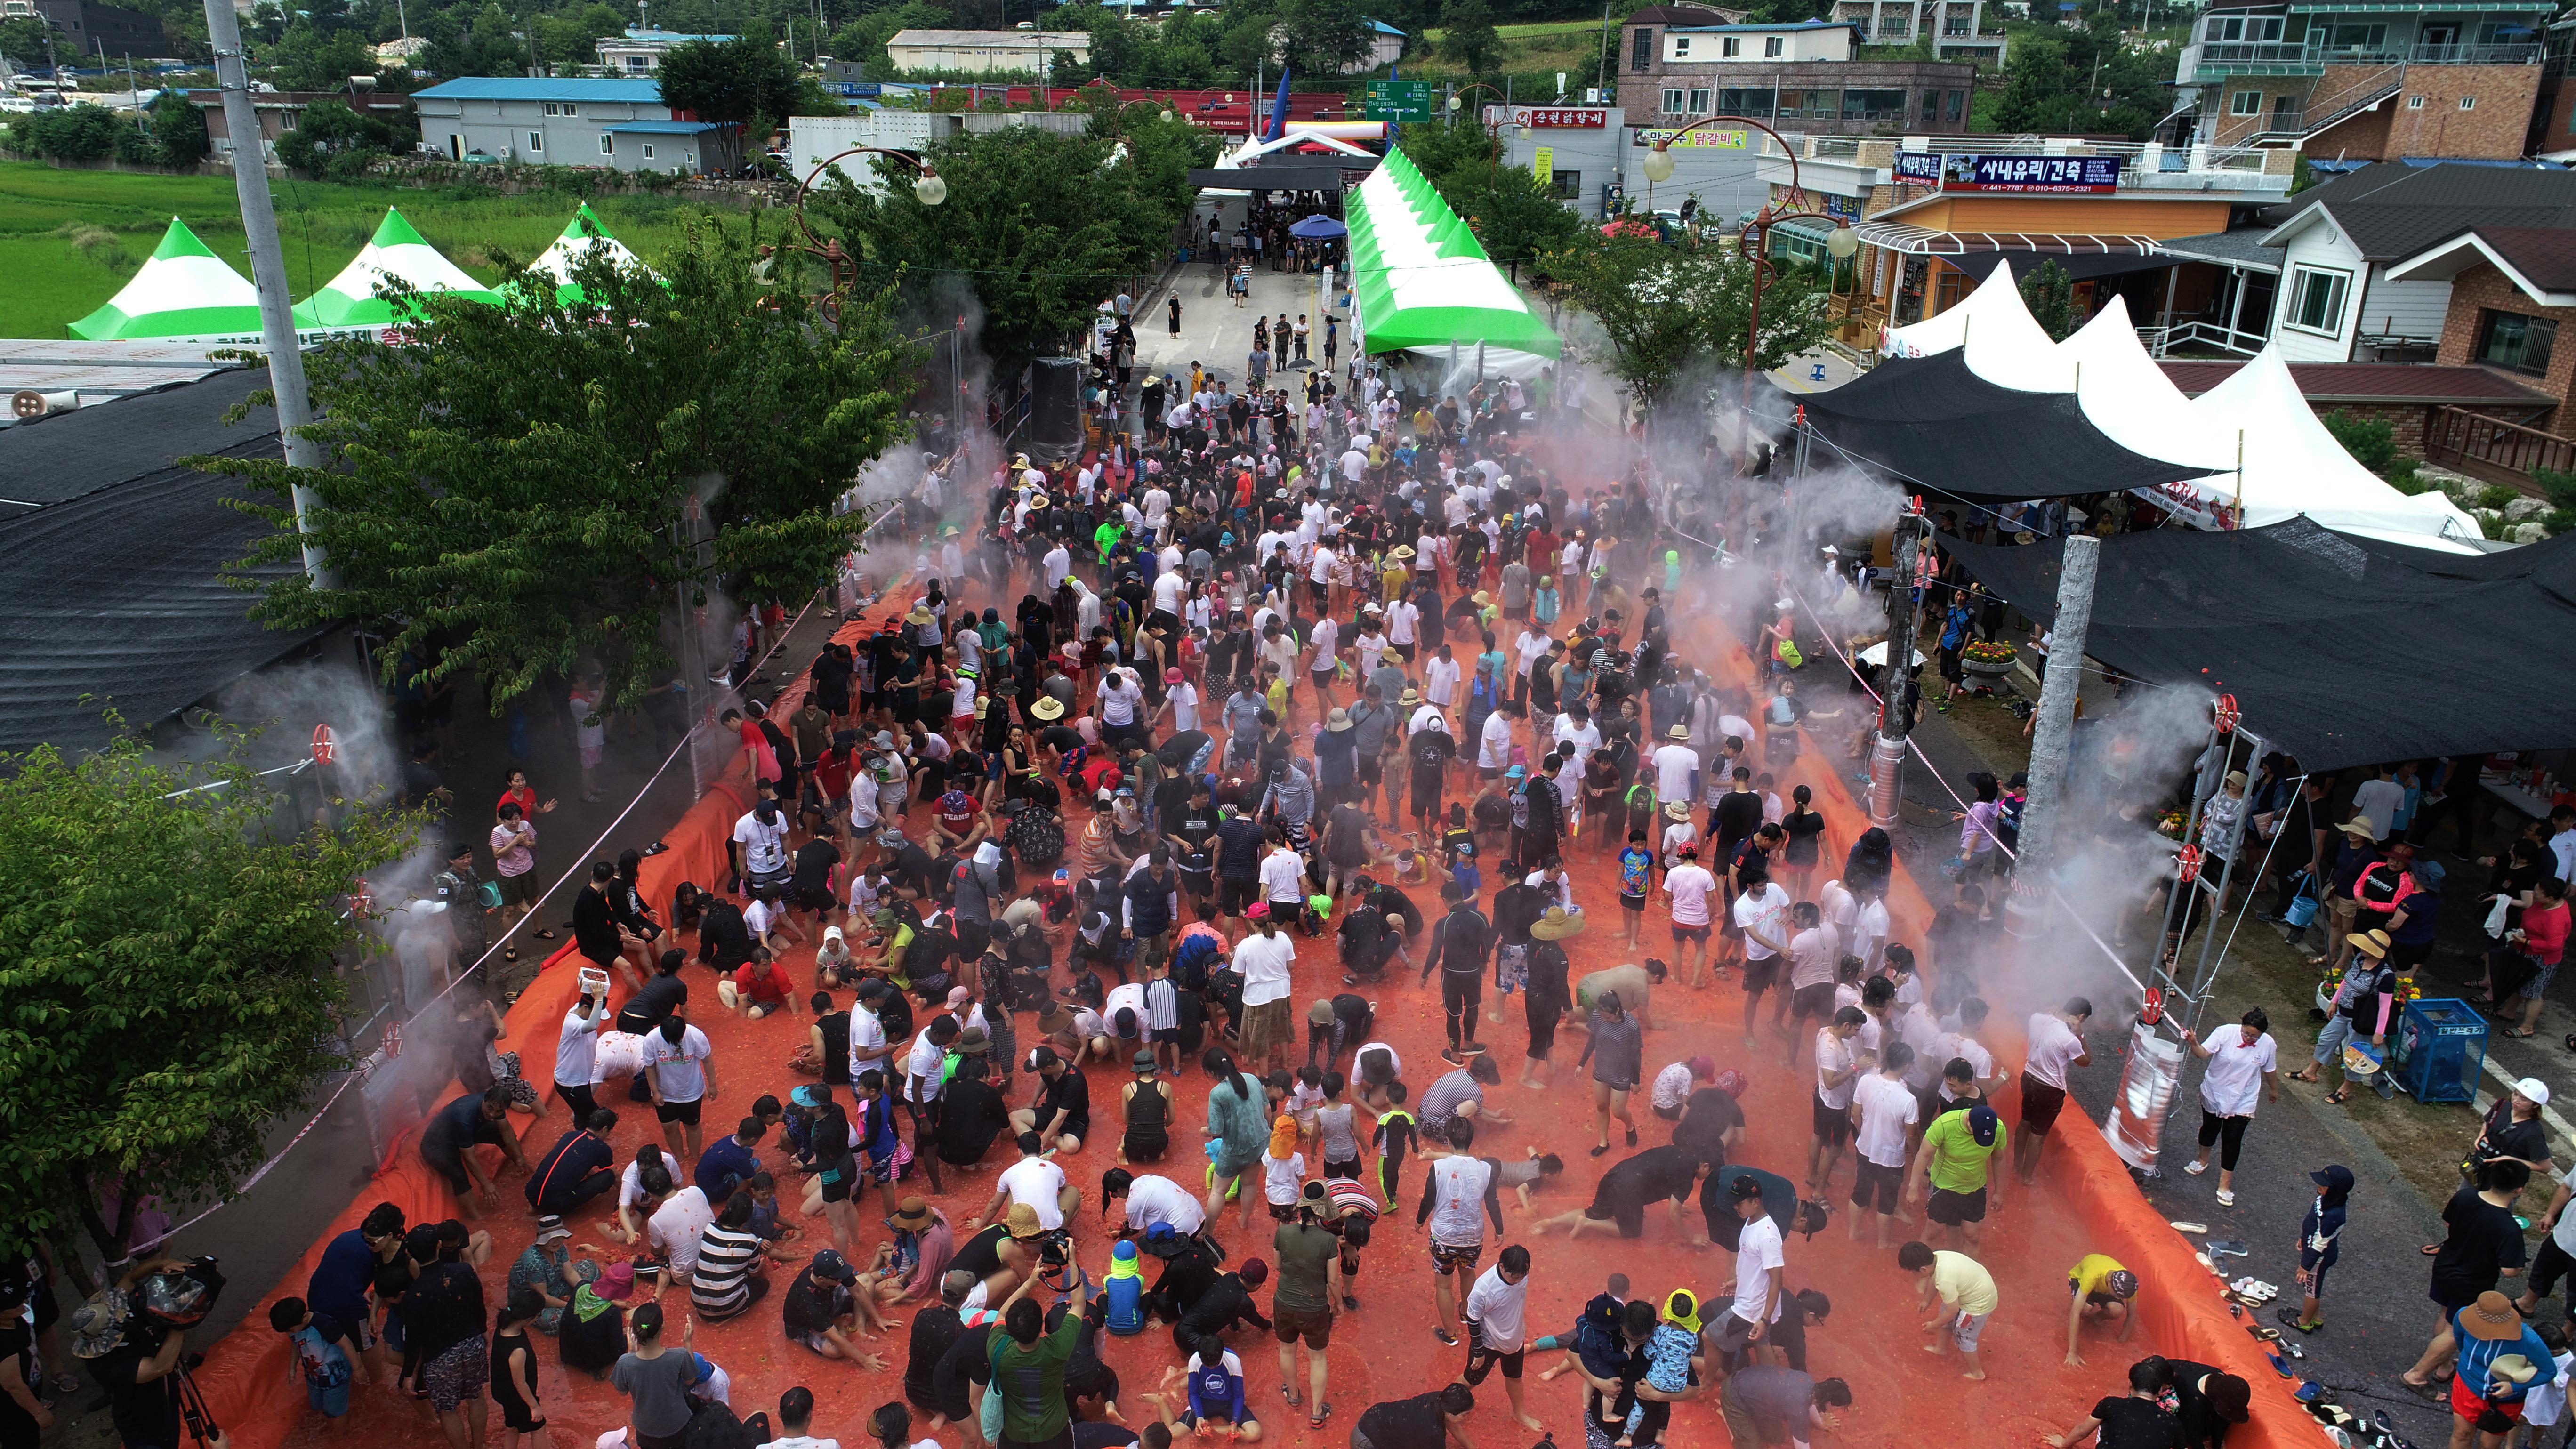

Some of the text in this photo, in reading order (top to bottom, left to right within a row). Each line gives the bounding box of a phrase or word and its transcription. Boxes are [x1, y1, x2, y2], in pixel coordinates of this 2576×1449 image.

[1534, 111, 1602, 124] 춘천닭갈비
[1901, 155, 1930, 176] 사내유리/건축
[1981, 160, 2081, 182] 사내유리/건축
[1254, 707, 1260, 716] P
[943, 813, 970, 821] TEAMS
[2367, 875, 2393, 892] Discovery
[836, 1256, 844, 1267] B
